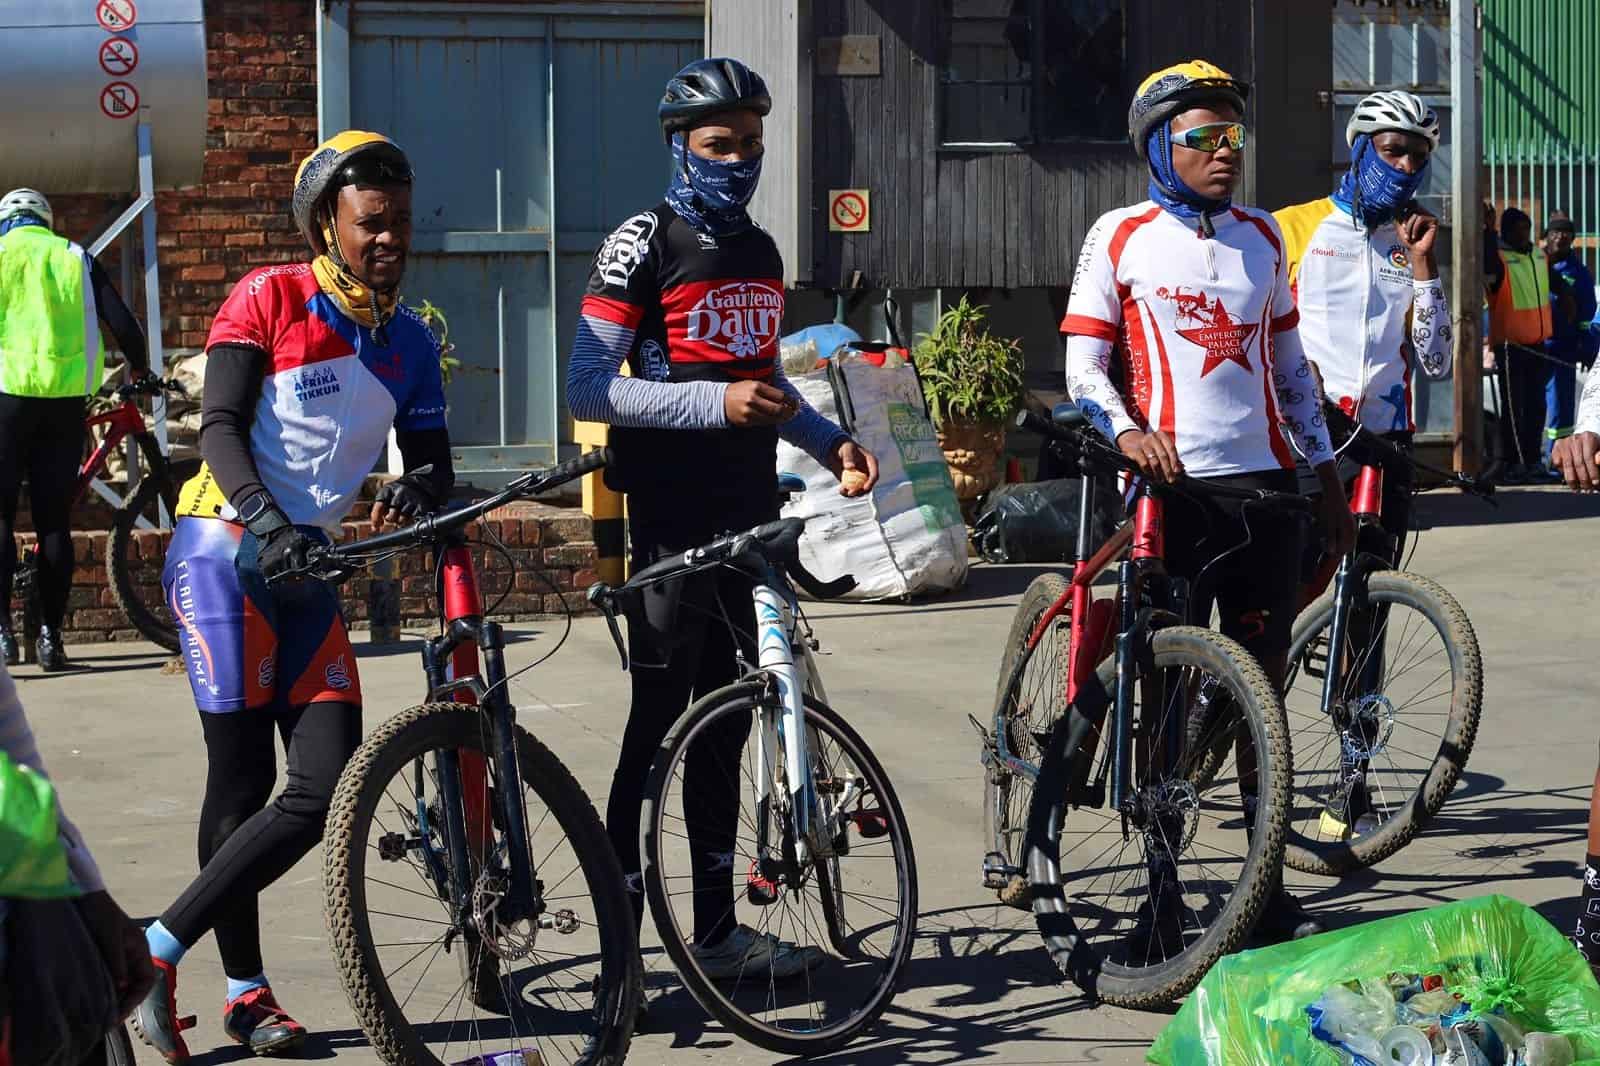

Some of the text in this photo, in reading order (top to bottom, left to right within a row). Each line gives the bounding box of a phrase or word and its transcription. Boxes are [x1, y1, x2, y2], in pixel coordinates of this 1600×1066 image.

[683, 308, 779, 341] Dair
[1207, 347, 1244, 358] CLASSIC
[1208, 339, 1241, 349] PALACE
[295, 374, 337, 392] AFRIKA
[1135, 351, 1148, 402] PALACE
[296, 383, 340, 401] TIKKUN
